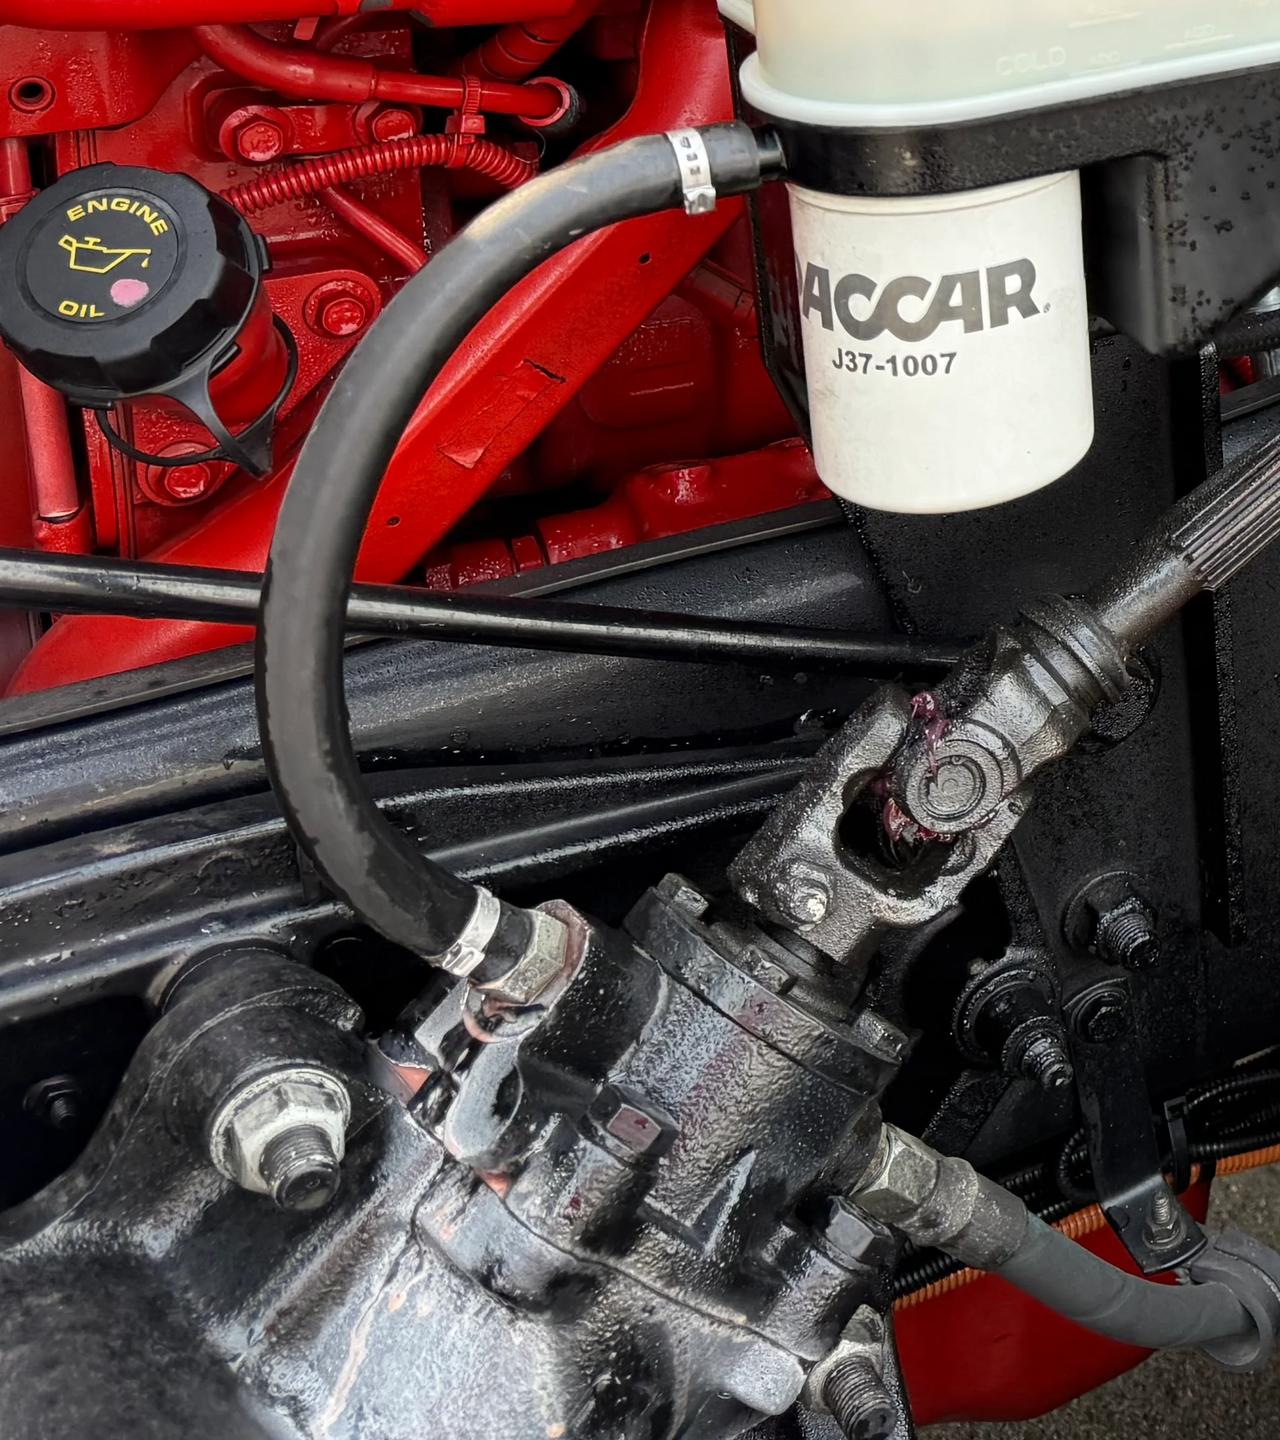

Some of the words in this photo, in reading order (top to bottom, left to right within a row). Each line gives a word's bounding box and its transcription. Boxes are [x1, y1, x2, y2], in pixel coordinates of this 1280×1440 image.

[996, 45, 1067, 77] COLD
[66, 197, 169, 237] ENGINE
[57, 299, 105, 318] OIL
[794, 252, 1041, 343] ACCAR
[832, 347, 957, 377] J37-1007
